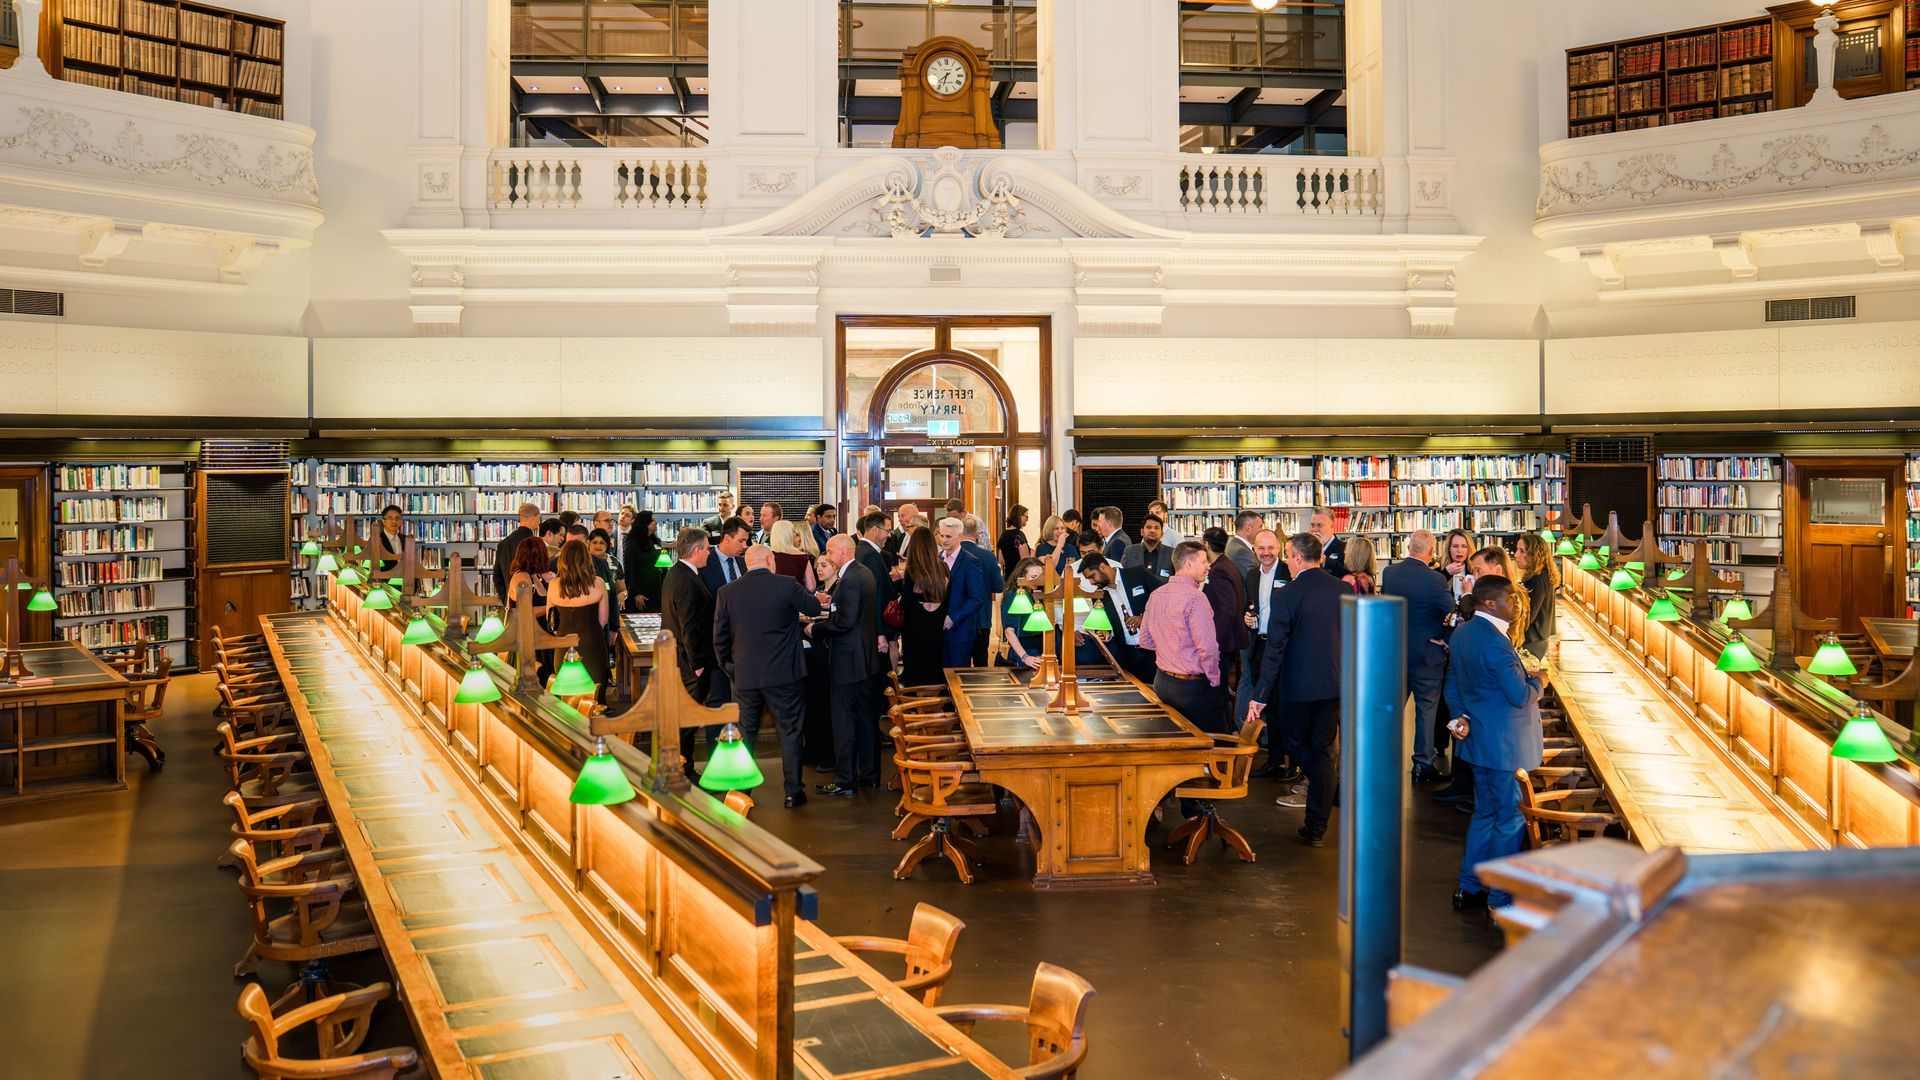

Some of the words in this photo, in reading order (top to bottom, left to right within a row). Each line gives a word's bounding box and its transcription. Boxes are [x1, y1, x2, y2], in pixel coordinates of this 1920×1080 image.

[83, 341, 122, 355] WHO
[127, 343, 164, 356] DOES
[1568, 350, 1587, 361] NO
[1591, 348, 1629, 360] PLACE
[1664, 345, 1680, 358] BE
[1683, 344, 1741, 357] CHOSEN
[1744, 341, 1790, 354] MORE
[1841, 337, 1862, 350] TO
[1683, 364, 1762, 378] REMINDERS
[1768, 362, 1788, 375] OF
